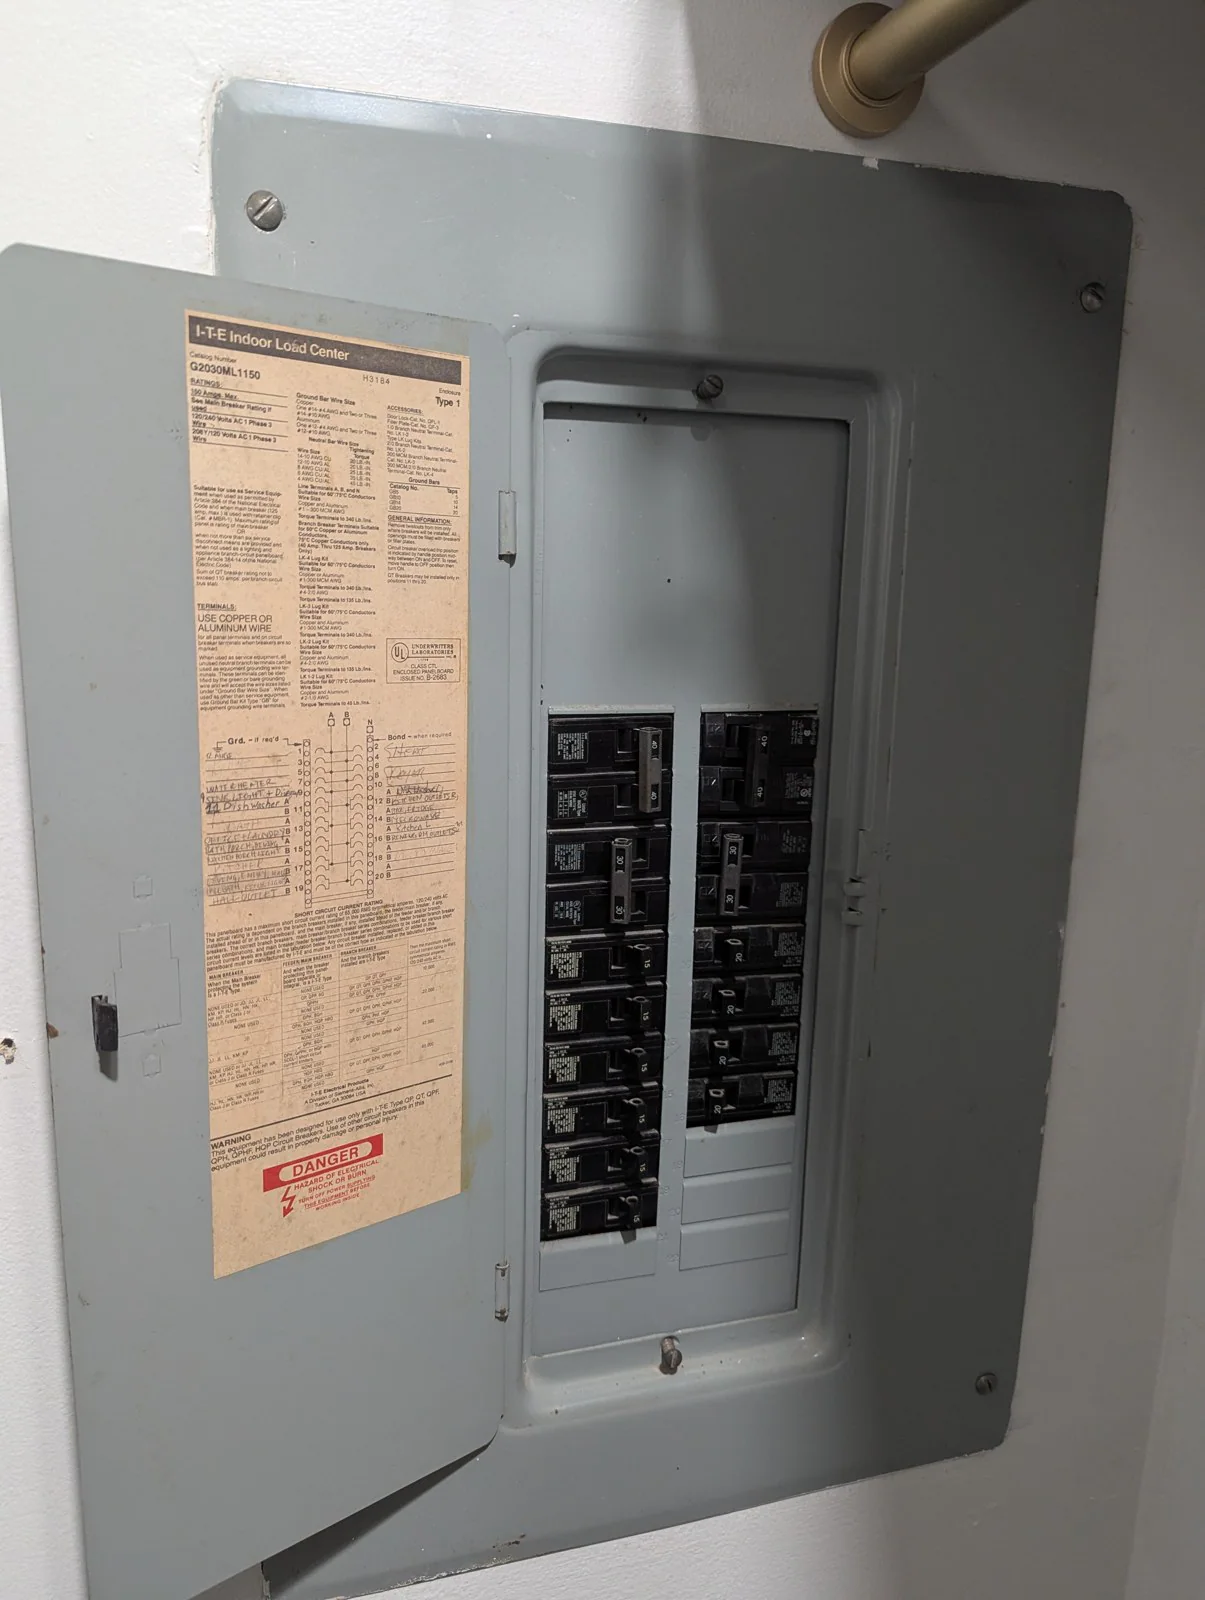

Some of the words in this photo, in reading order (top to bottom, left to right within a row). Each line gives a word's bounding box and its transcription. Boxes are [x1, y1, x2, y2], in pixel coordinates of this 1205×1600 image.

[196, 325, 227, 341] I-T-E
[230, 331, 272, 348] Indoor
[276, 338, 307, 354] Load
[310, 344, 350, 361] Center
[190, 351, 212, 361] Catalog
[215, 355, 237, 363] Number
[190, 362, 260, 380] G2030ML1150
[363, 375, 390, 384] H3184
[439, 388, 461, 396] Enclosure
[296, 393, 318, 402] Ground
[435, 397, 453, 407] Type
[221, 401, 245, 409] Breaker
[246, 404, 266, 413] Rating
[387, 405, 423, 414] ACCESSORIES:
[192, 413, 216, 421] 120/240
[198, 614, 217, 622] USE
[219, 614, 257, 622] COPPER
[198, 624, 247, 632] ALUMINUM
[248, 624, 272, 632] WIRE
[395, 646, 405, 659] UL
[761, 736, 767, 747] 40
[757, 787, 763, 797] 40
[730, 846, 736, 855] 30
[617, 856, 623, 864] 30
[726, 894, 733, 903] 30
[315, 907, 336, 915] CIRCUIT
[338, 903, 363, 911] CURRENT
[616, 906, 622, 914] 30
[735, 953, 743, 962] 20
[645, 960, 650, 968] 15
[727, 1005, 735, 1014] 20
[643, 1012, 649, 1021] 15
[719, 1056, 726, 1065] 20
[642, 1063, 647, 1072] 15
[324, 1084, 346, 1093] Electrical
[348, 1079, 369, 1087] Products
[714, 1104, 721, 1114] 20
[211, 1149, 226, 1157] This
[227, 1140, 262, 1153] equipment
[264, 1135, 276, 1143] has
[278, 1131, 294, 1139] been
[296, 1121, 324, 1134] designed
[326, 1118, 335, 1126] for
[348, 1112, 361, 1121] only
[362, 1107, 373, 1116] with
[375, 1102, 388, 1112] I-T-E
[390, 1100, 403, 1109] Type
[405, 1096, 415, 1105] QP,
[416, 1092, 425, 1101] QT,
[426, 1089, 440, 1098] QPF,
[639, 1114, 645, 1123] 15
[211, 1155, 229, 1165] QPH,
[232, 1149, 253, 1159] QPHF,
[255, 1141, 271, 1152] HQP
[273, 1136, 294, 1147] Circuit
[295, 1129, 324, 1140] Breakers.
[326, 1124, 339, 1132] Use
[348, 1117, 363, 1127] other
[364, 1112, 382, 1122] circuit
[383, 1106, 407, 1117] breakers
[211, 1133, 252, 1150] WARNING
[211, 1157, 247, 1172] equipment
[248, 1151, 267, 1161] could
[268, 1145, 286, 1155] result
[295, 1136, 320, 1149] property
[322, 1128, 347, 1140] damage
[356, 1117, 381, 1132] personal
[382, 1114, 398, 1124] injury.
[293, 1147, 359, 1177] DANGER
[640, 1163, 646, 1172] 15
[294, 1177, 323, 1190] HAZARD
[338, 1160, 379, 1176] ELECTRICAL
[308, 1181, 333, 1193] SHOCK
[348, 1169, 367, 1180] BURN
[298, 1195, 313, 1203] TURN
[327, 1186, 345, 1194] POWER
[347, 1175, 376, 1188] SUPPLYING
[304, 1200, 317, 1208] THIS
[318, 1191, 349, 1204] EQUIPMENT
[350, 1183, 370, 1193] BEFORE
[316, 1199, 341, 1211] WORKING
[343, 1193, 360, 1202] INSIDE
[634, 1214, 640, 1223] 15
